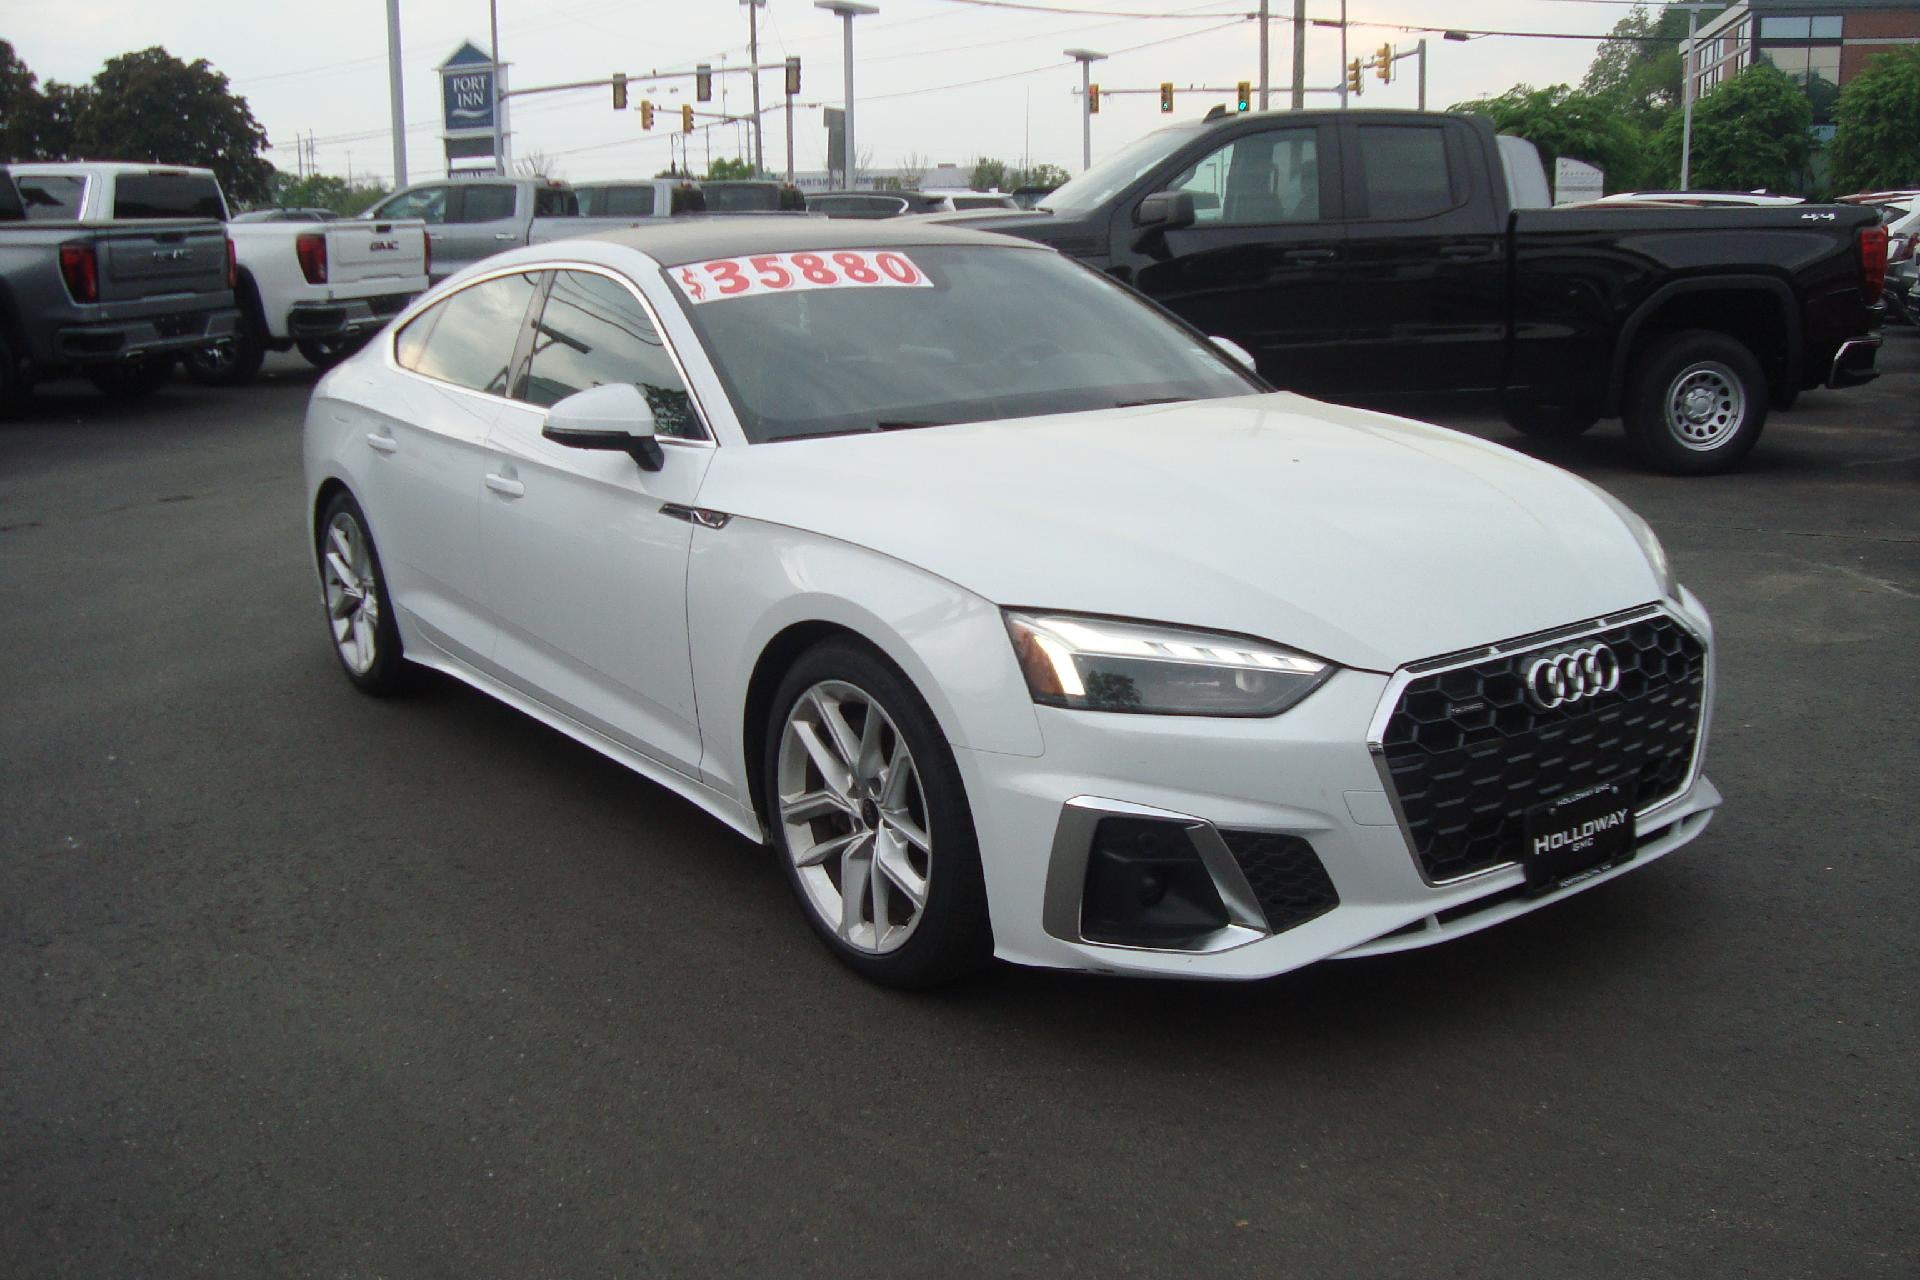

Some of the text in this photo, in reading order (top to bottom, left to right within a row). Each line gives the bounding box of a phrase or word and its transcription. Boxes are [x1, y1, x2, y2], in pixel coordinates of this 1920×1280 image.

[453, 75, 486, 93] PORT
[457, 91, 484, 107] INN
[682, 252, 920, 300] $35880
[1534, 808, 1628, 855] HOLLOWAY
